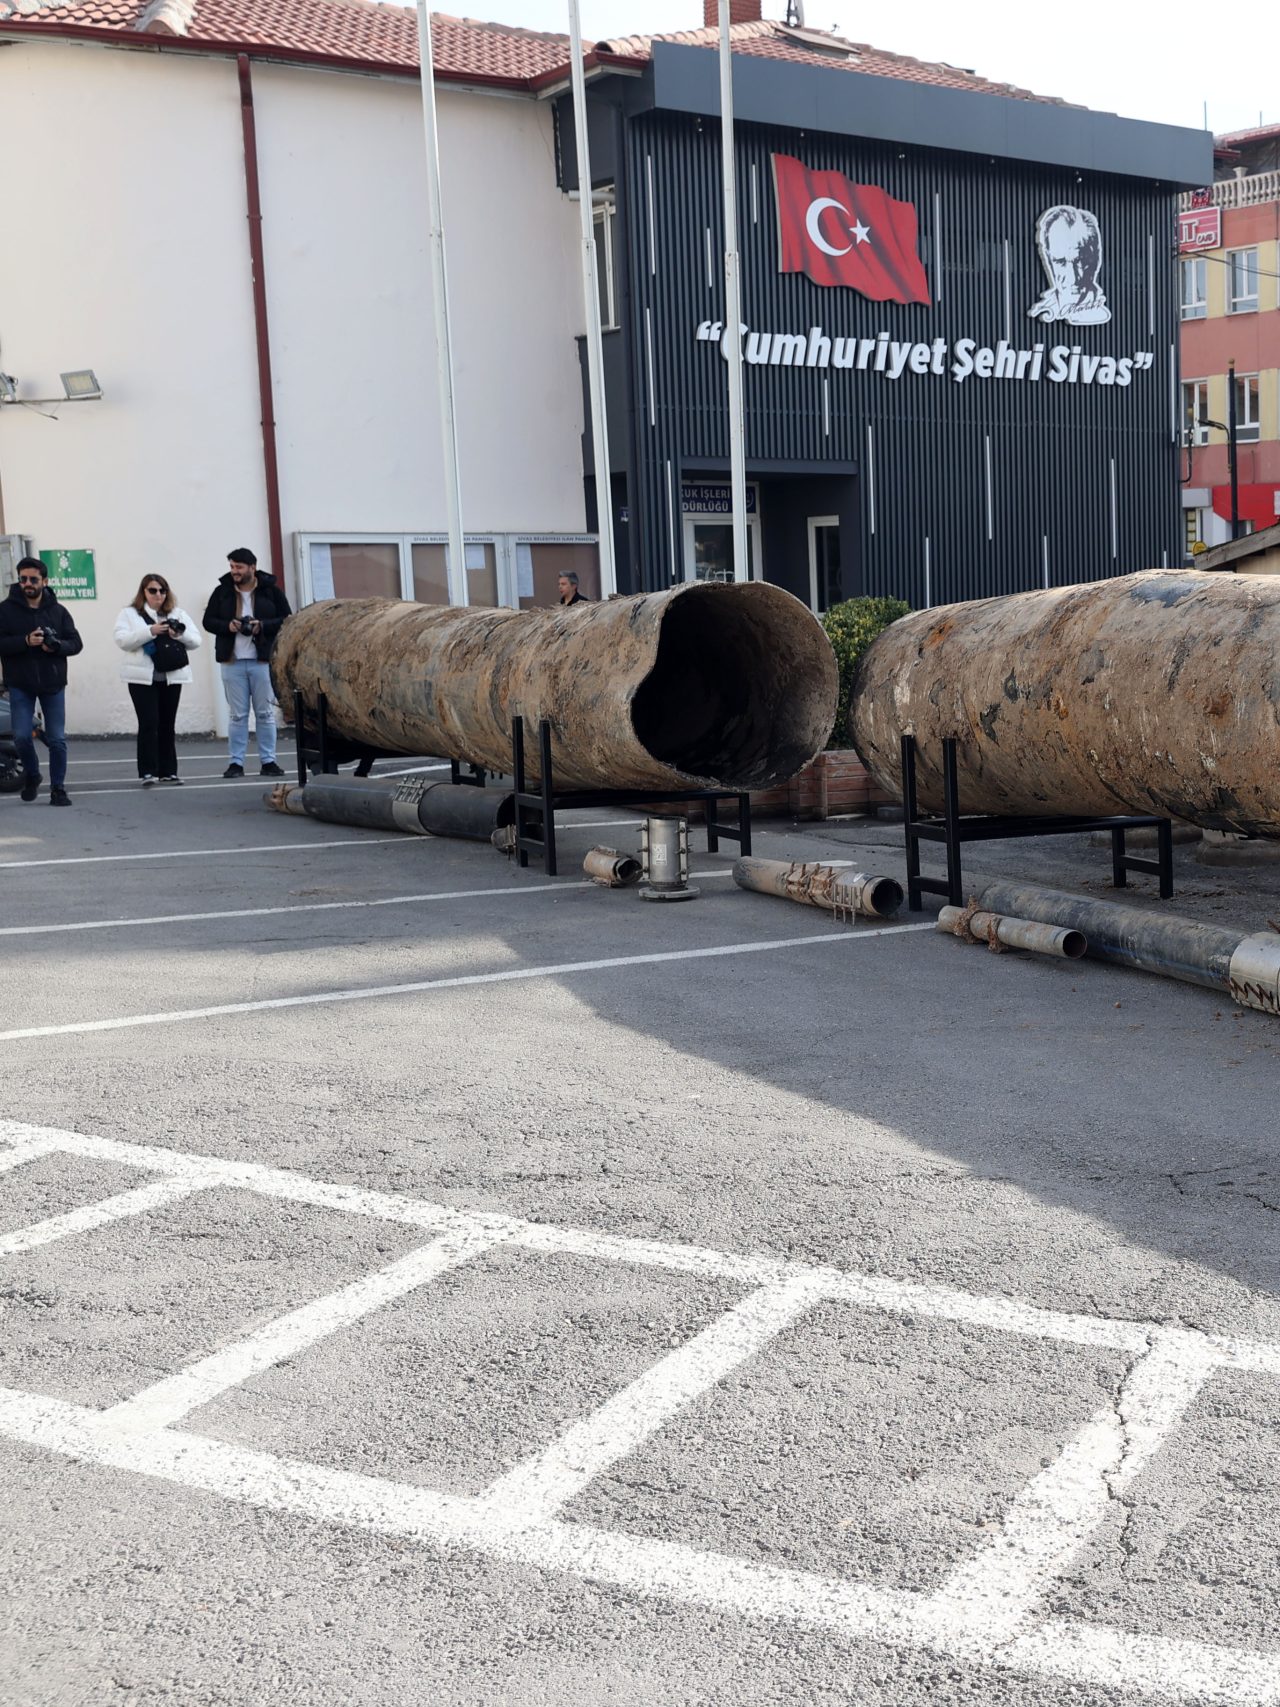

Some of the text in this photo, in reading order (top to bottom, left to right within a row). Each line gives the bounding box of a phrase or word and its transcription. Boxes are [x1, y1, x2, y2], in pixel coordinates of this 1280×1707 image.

[951, 337, 1044, 383] Şehri
[700, 487, 730, 501] İŞLERİ
[62, 577, 87, 586] DURUM
[77, 586, 95, 597] YERİ
